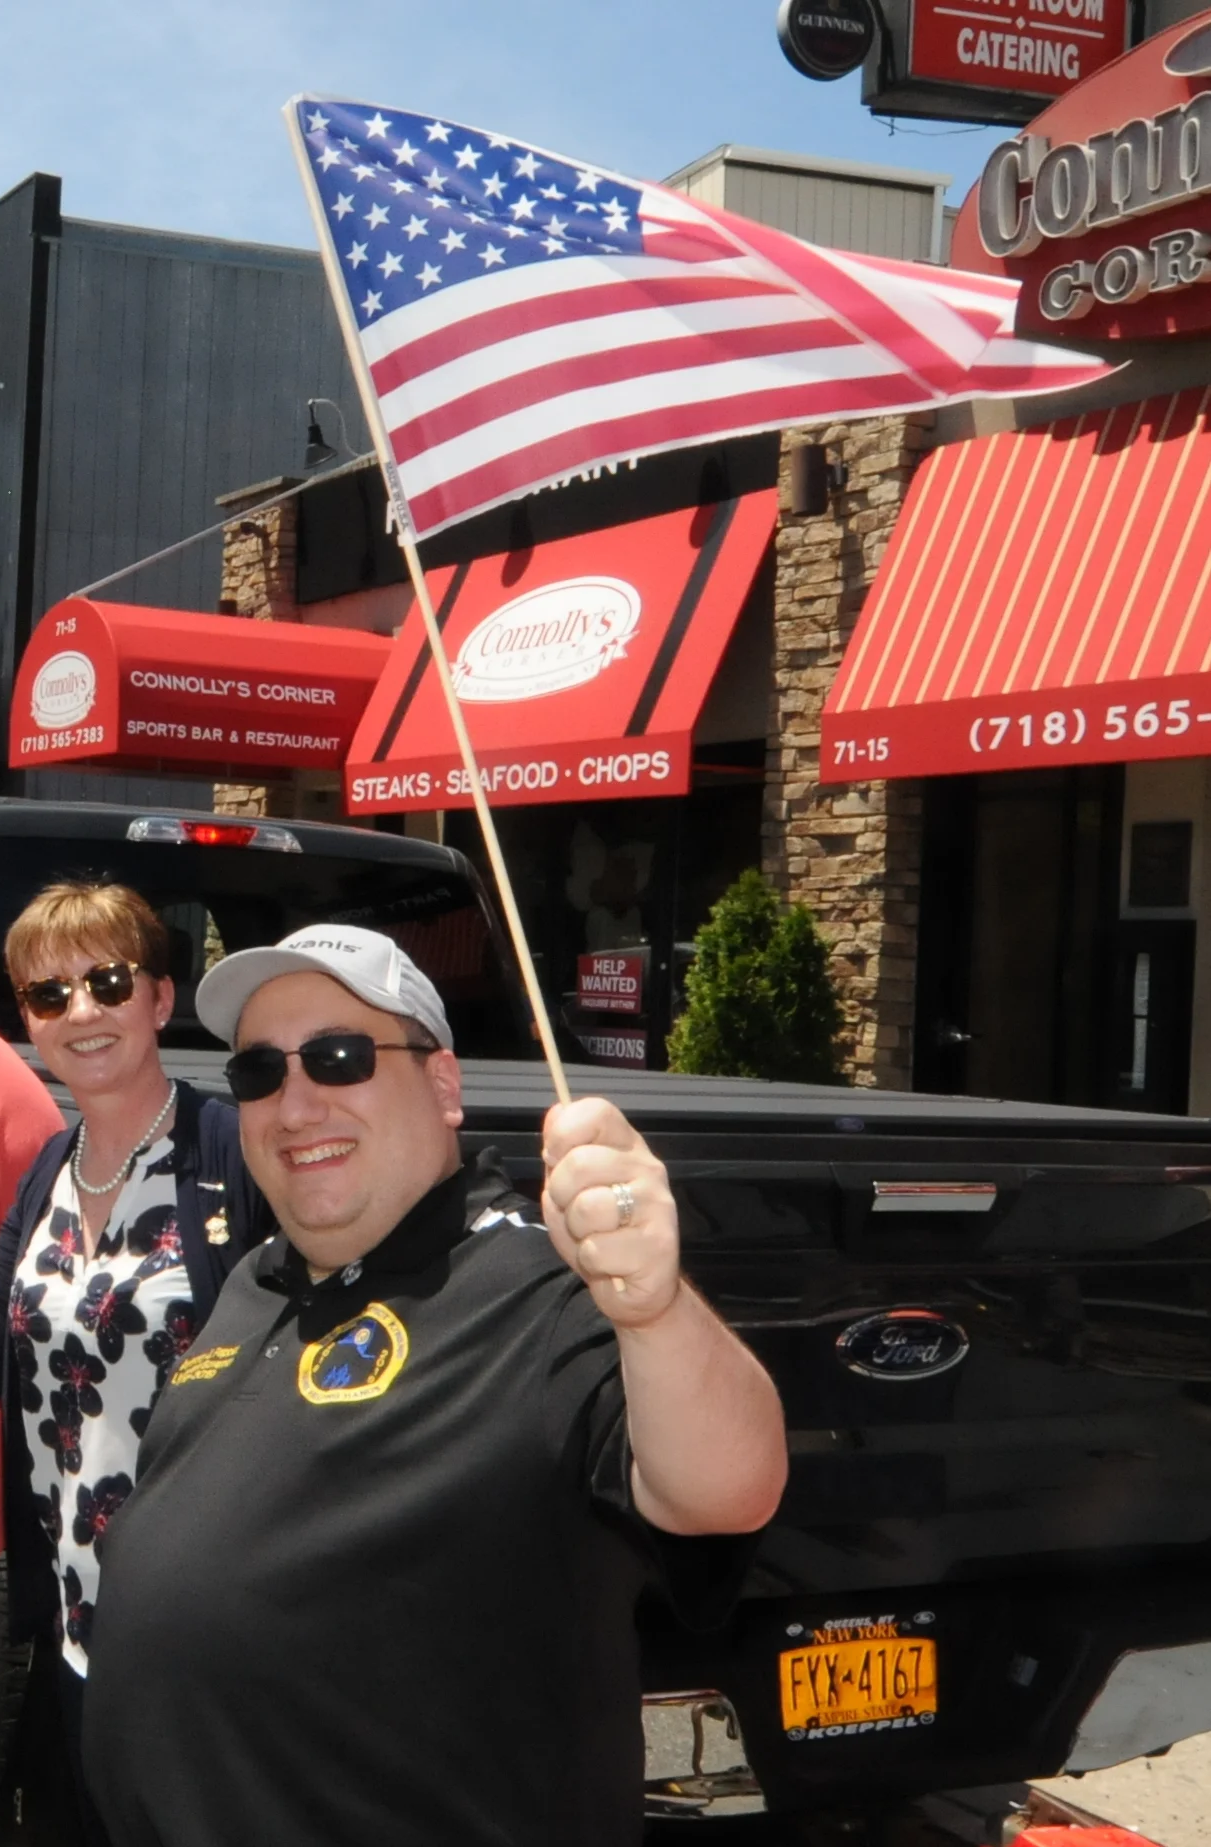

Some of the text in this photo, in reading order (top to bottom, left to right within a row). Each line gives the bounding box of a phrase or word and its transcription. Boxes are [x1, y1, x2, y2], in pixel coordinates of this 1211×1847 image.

[798, 13, 865, 34] GUINNESS
[956, 27, 1080, 80] CATERING
[55, 617, 77, 637] 71-15
[480, 606, 617, 657] Connolly's
[39, 671, 88, 700] Connolly's
[129, 669, 337, 706] CONNOLLY'S CORNER
[20, 725, 105, 754] (718) 565-7383
[126, 720, 341, 752] SPORTS BAR & RESTAURANT
[968, 708, 1087, 753] (718)
[833, 737, 889, 765] 71-15
[352, 772, 431, 803] STEAKS
[578, 751, 671, 786] CHOPS
[592, 959, 626, 975] HELP
[581, 975, 637, 993] WANTED
[873, 1326, 943, 1364] Ford
[813, 1627, 852, 1645] NEW
[857, 1623, 899, 1640] YORK
[878, 1614, 896, 1625] NY
[790, 1646, 923, 1711] FYX 4167
[807, 1716, 918, 1740] KOEPPEL
